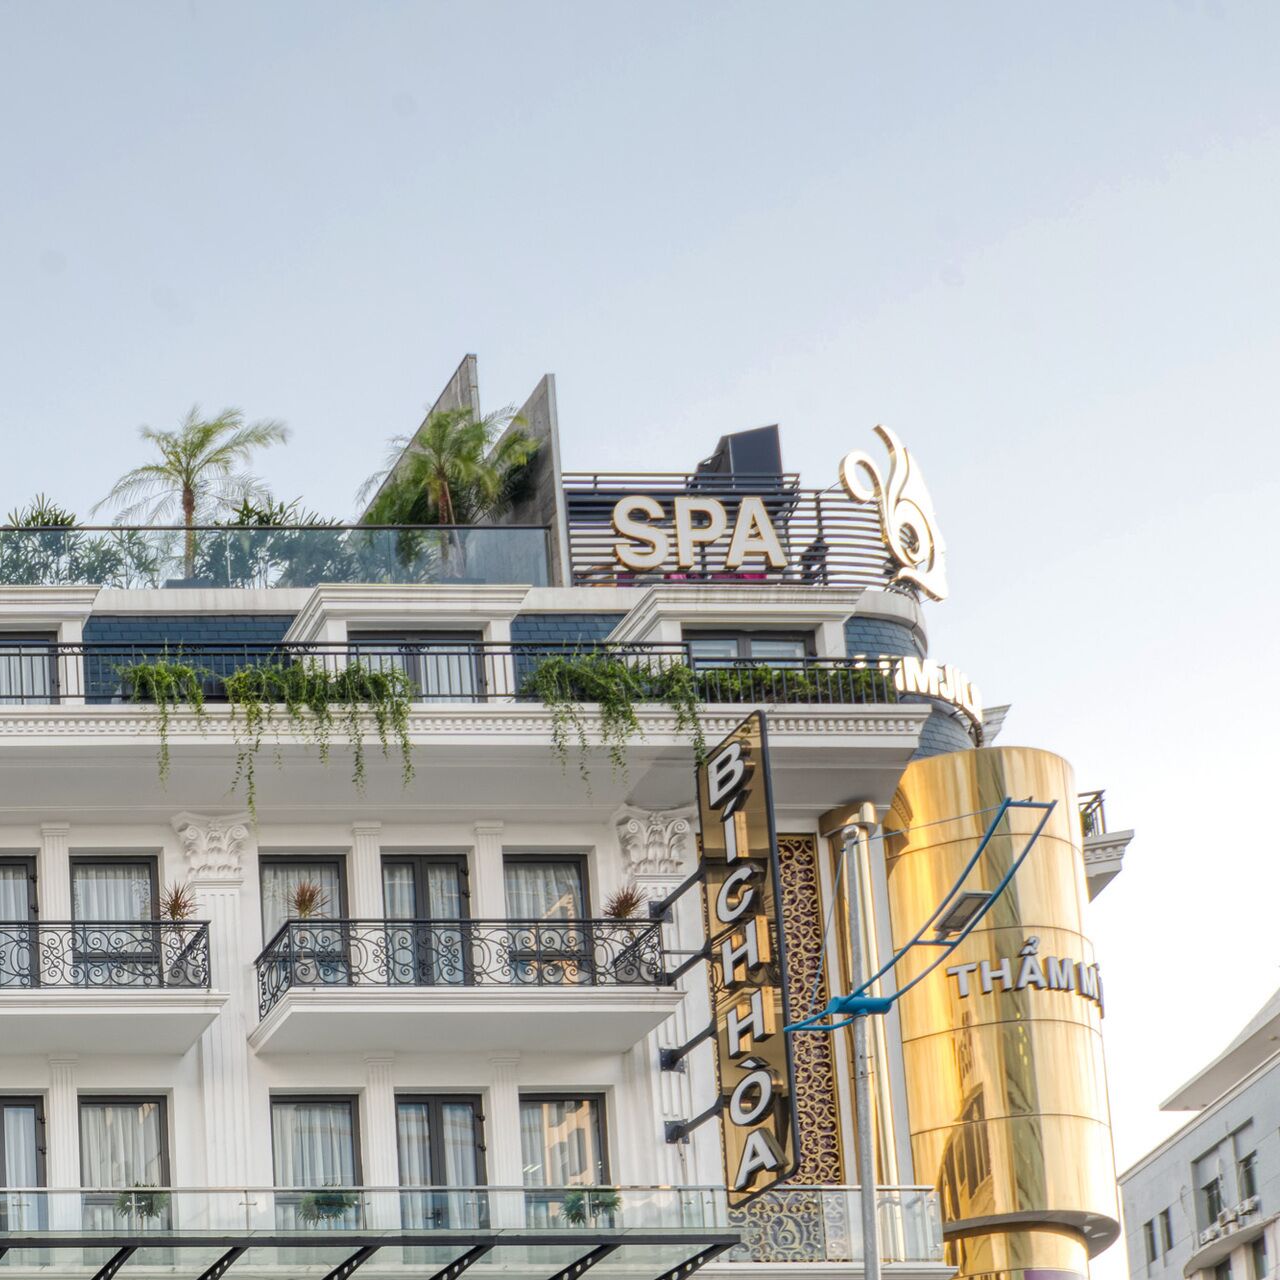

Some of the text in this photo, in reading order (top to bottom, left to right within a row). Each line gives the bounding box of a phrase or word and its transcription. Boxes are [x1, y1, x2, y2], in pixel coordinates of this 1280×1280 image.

[613, 495, 789, 568] SPA
[707, 742, 759, 987] BÍCH
[946, 936, 1075, 999] THẨM
